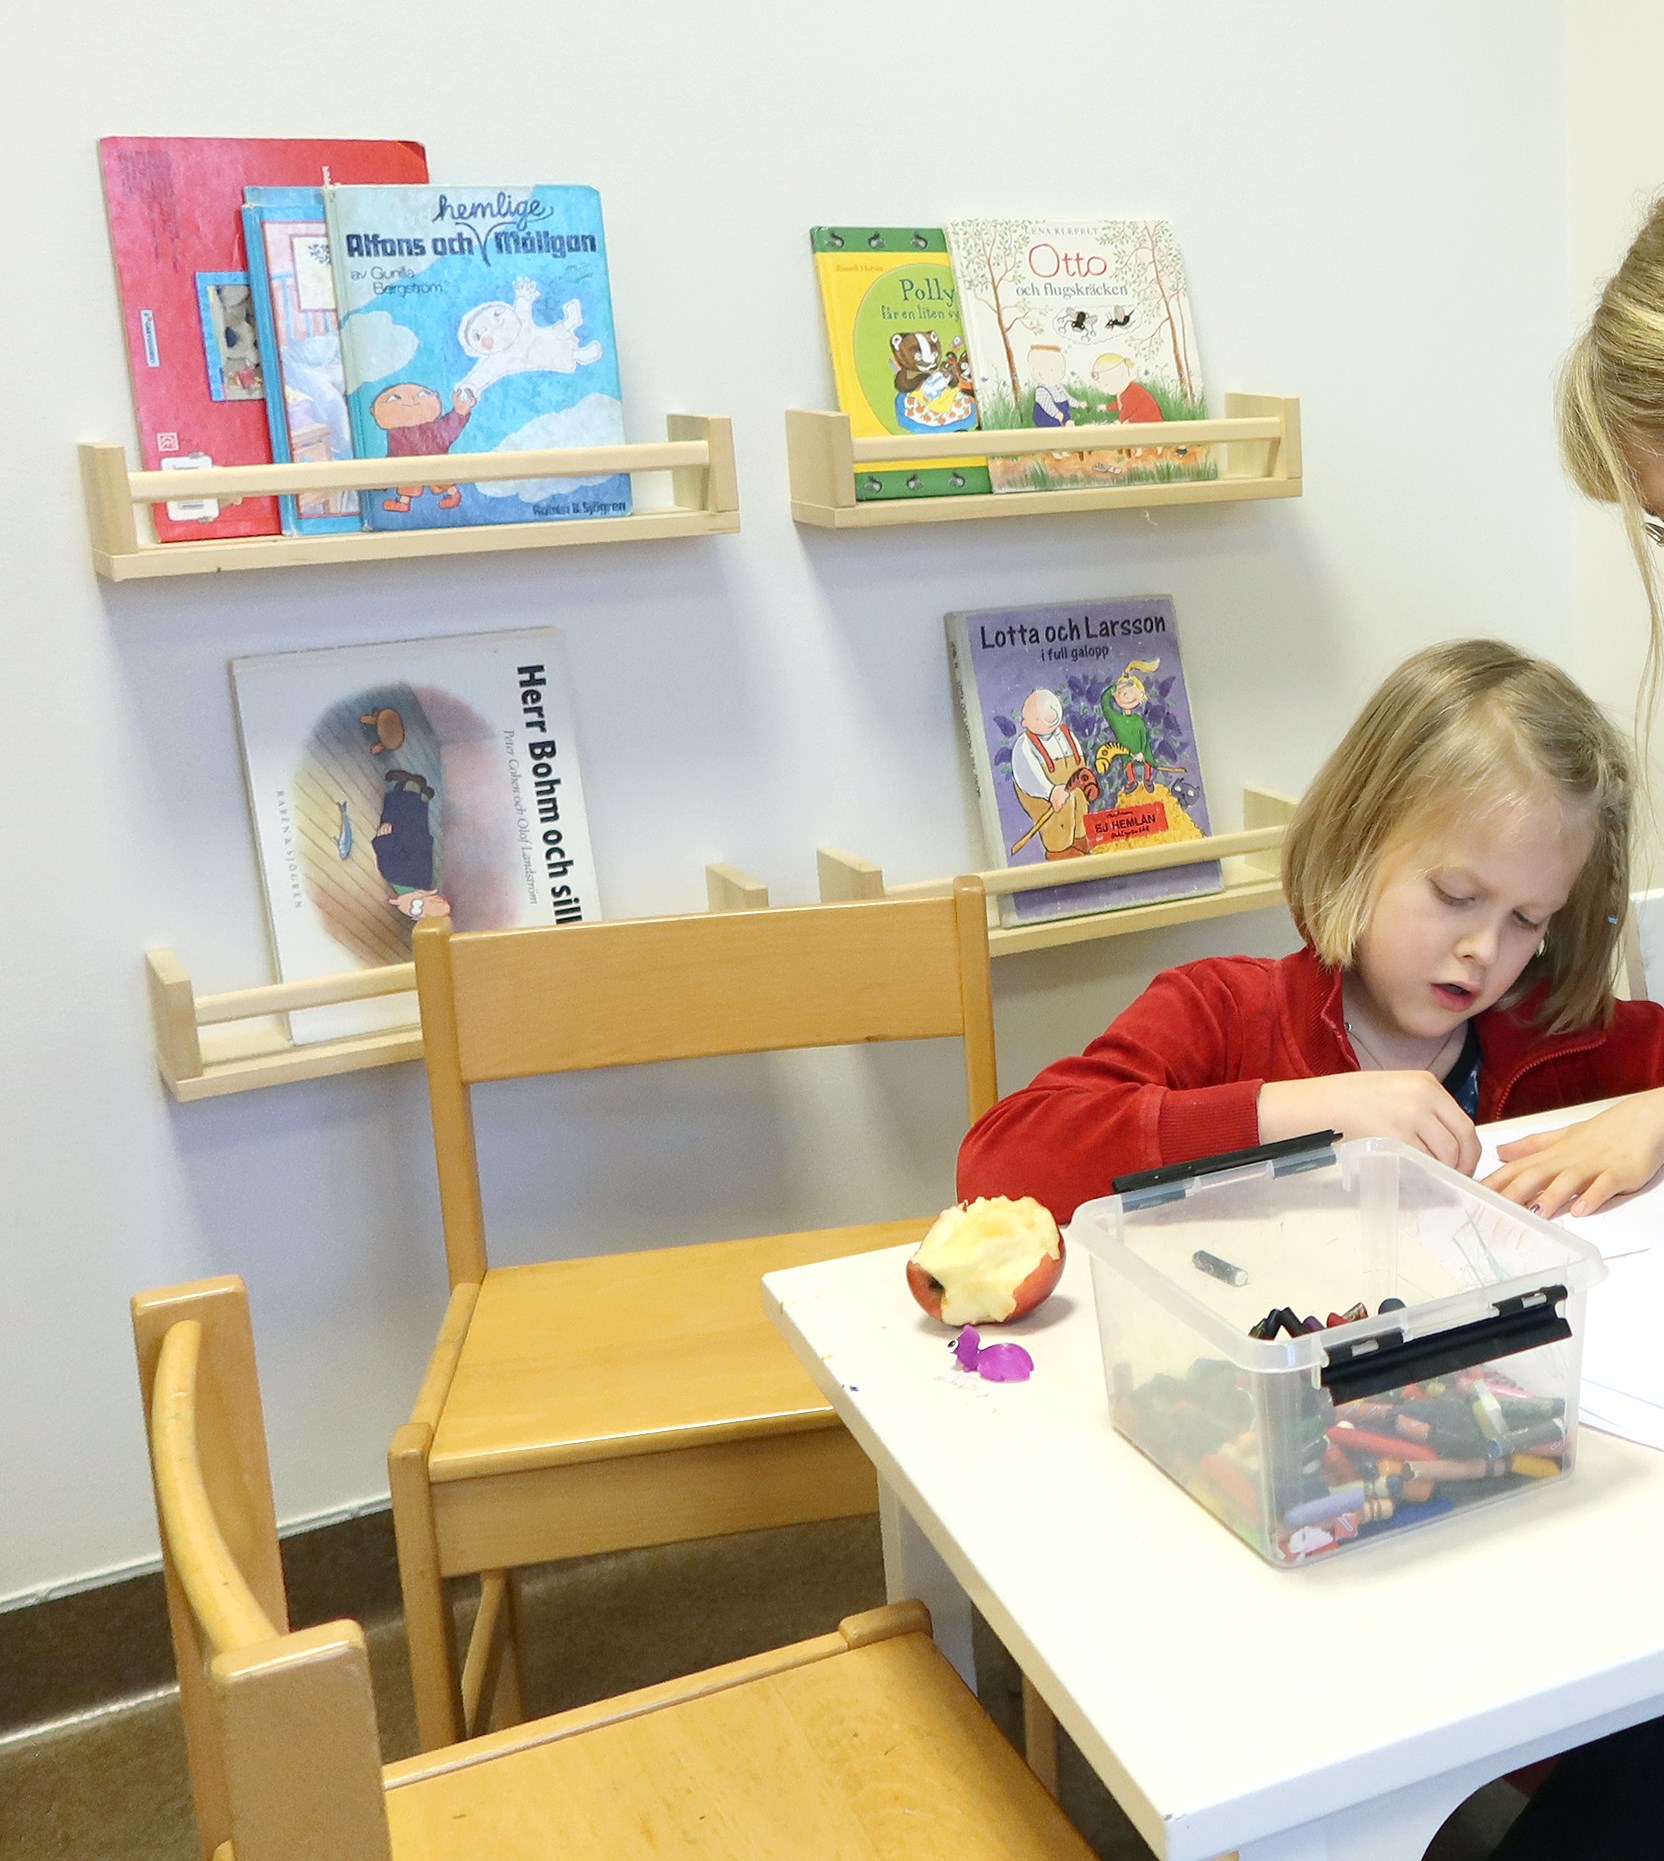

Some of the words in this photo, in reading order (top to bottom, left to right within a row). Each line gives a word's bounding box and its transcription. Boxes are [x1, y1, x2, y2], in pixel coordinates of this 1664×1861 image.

[432, 191, 555, 231] hemlige
[346, 233, 427, 258] Alfons
[432, 232, 474, 256] och
[494, 230, 597, 258] Mållgan
[1028, 243, 1108, 278] Otto
[899, 278, 955, 308] Polly
[1015, 282, 1042, 297] och
[1043, 282, 1128, 299] flugskräcken
[881, 305, 901, 320] får
[901, 311, 915, 320] en
[917, 305, 945, 320] liten
[980, 624, 1040, 650] Lotta
[1044, 617, 1081, 643] och
[1083, 615, 1167, 640] Larsson
[1041, 651, 1046, 662] i
[1047, 647, 1069, 661] full
[1071, 645, 1110, 663] galopp
[517, 664, 547, 733] Herr
[503, 730, 515, 756] Peter
[528, 739, 561, 824] Bohm
[513, 795, 527, 816] och
[517, 818, 532, 845] Olof
[1095, 822, 1108, 833] EJ
[542, 829, 574, 879] och
